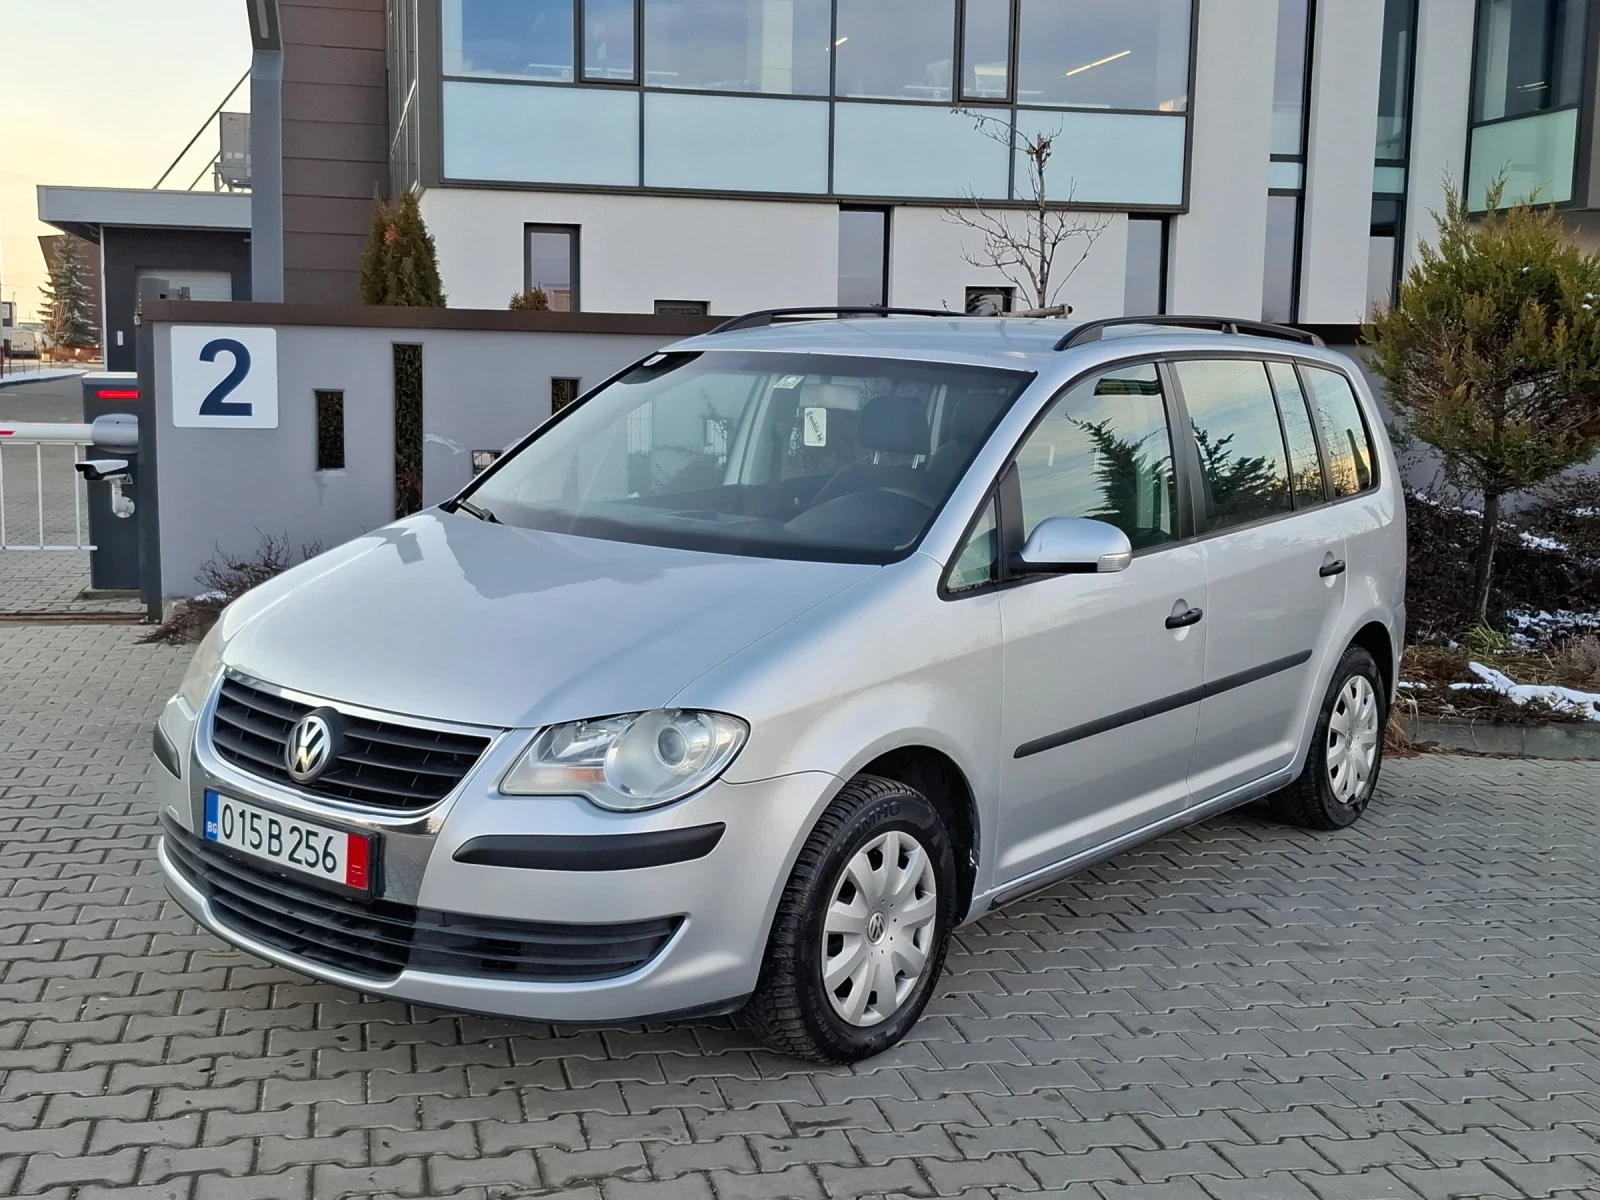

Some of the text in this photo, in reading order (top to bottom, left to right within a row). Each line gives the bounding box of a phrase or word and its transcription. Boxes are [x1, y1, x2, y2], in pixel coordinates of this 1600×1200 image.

[198, 338, 253, 416] 2
[285, 715, 332, 784] VW
[207, 821, 218, 834] BG
